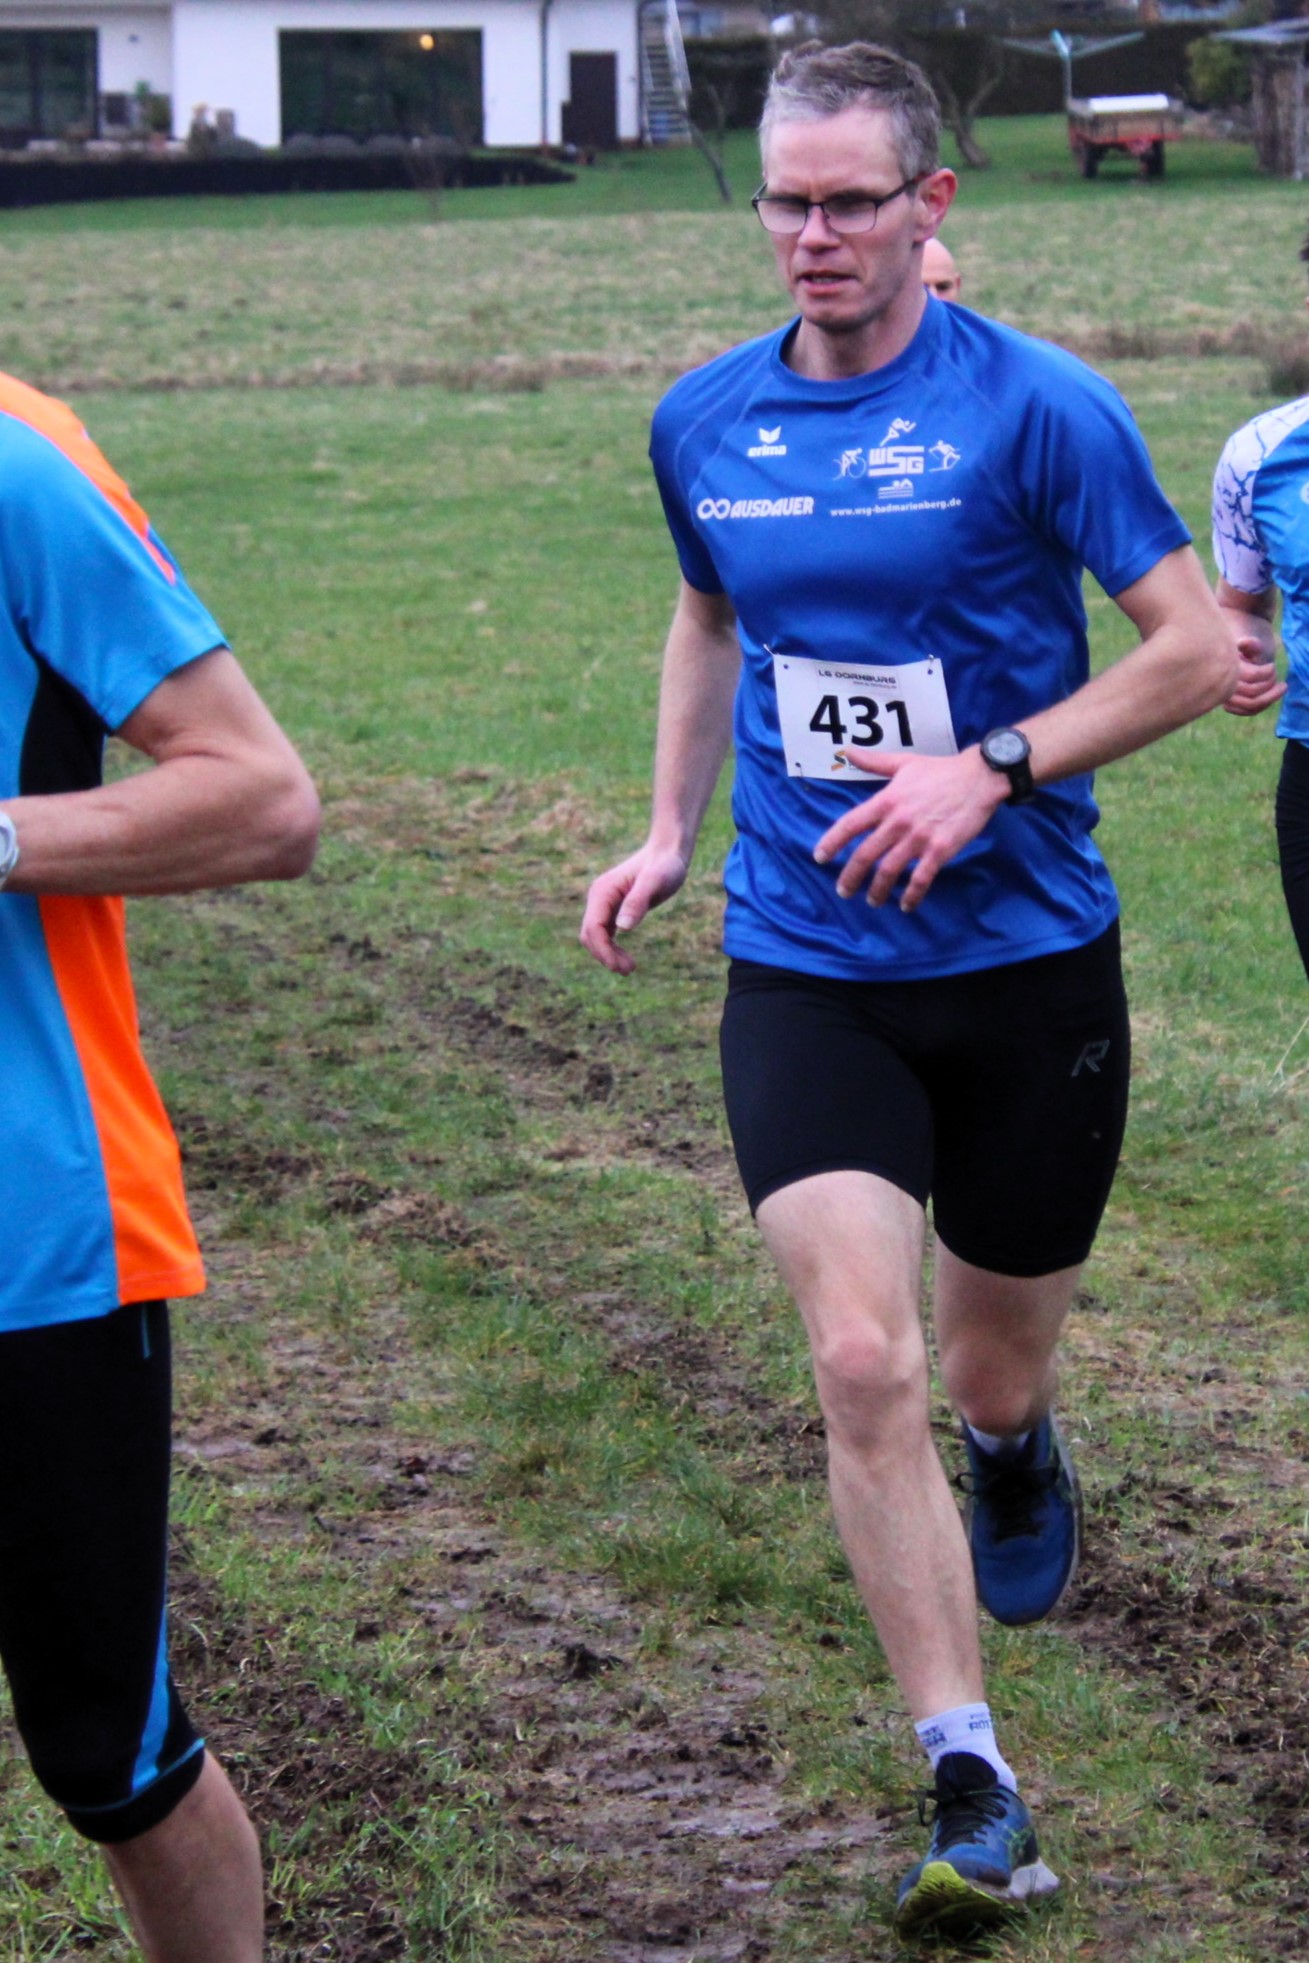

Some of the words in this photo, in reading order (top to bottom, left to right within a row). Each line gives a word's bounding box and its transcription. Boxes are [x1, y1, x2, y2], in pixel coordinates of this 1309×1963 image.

[868, 446, 924, 476] WSG
[730, 497, 814, 518] AUSDAUER
[830, 498, 962, 516] www.wsg-badmarienberg.de
[809, 695, 914, 747] 431
